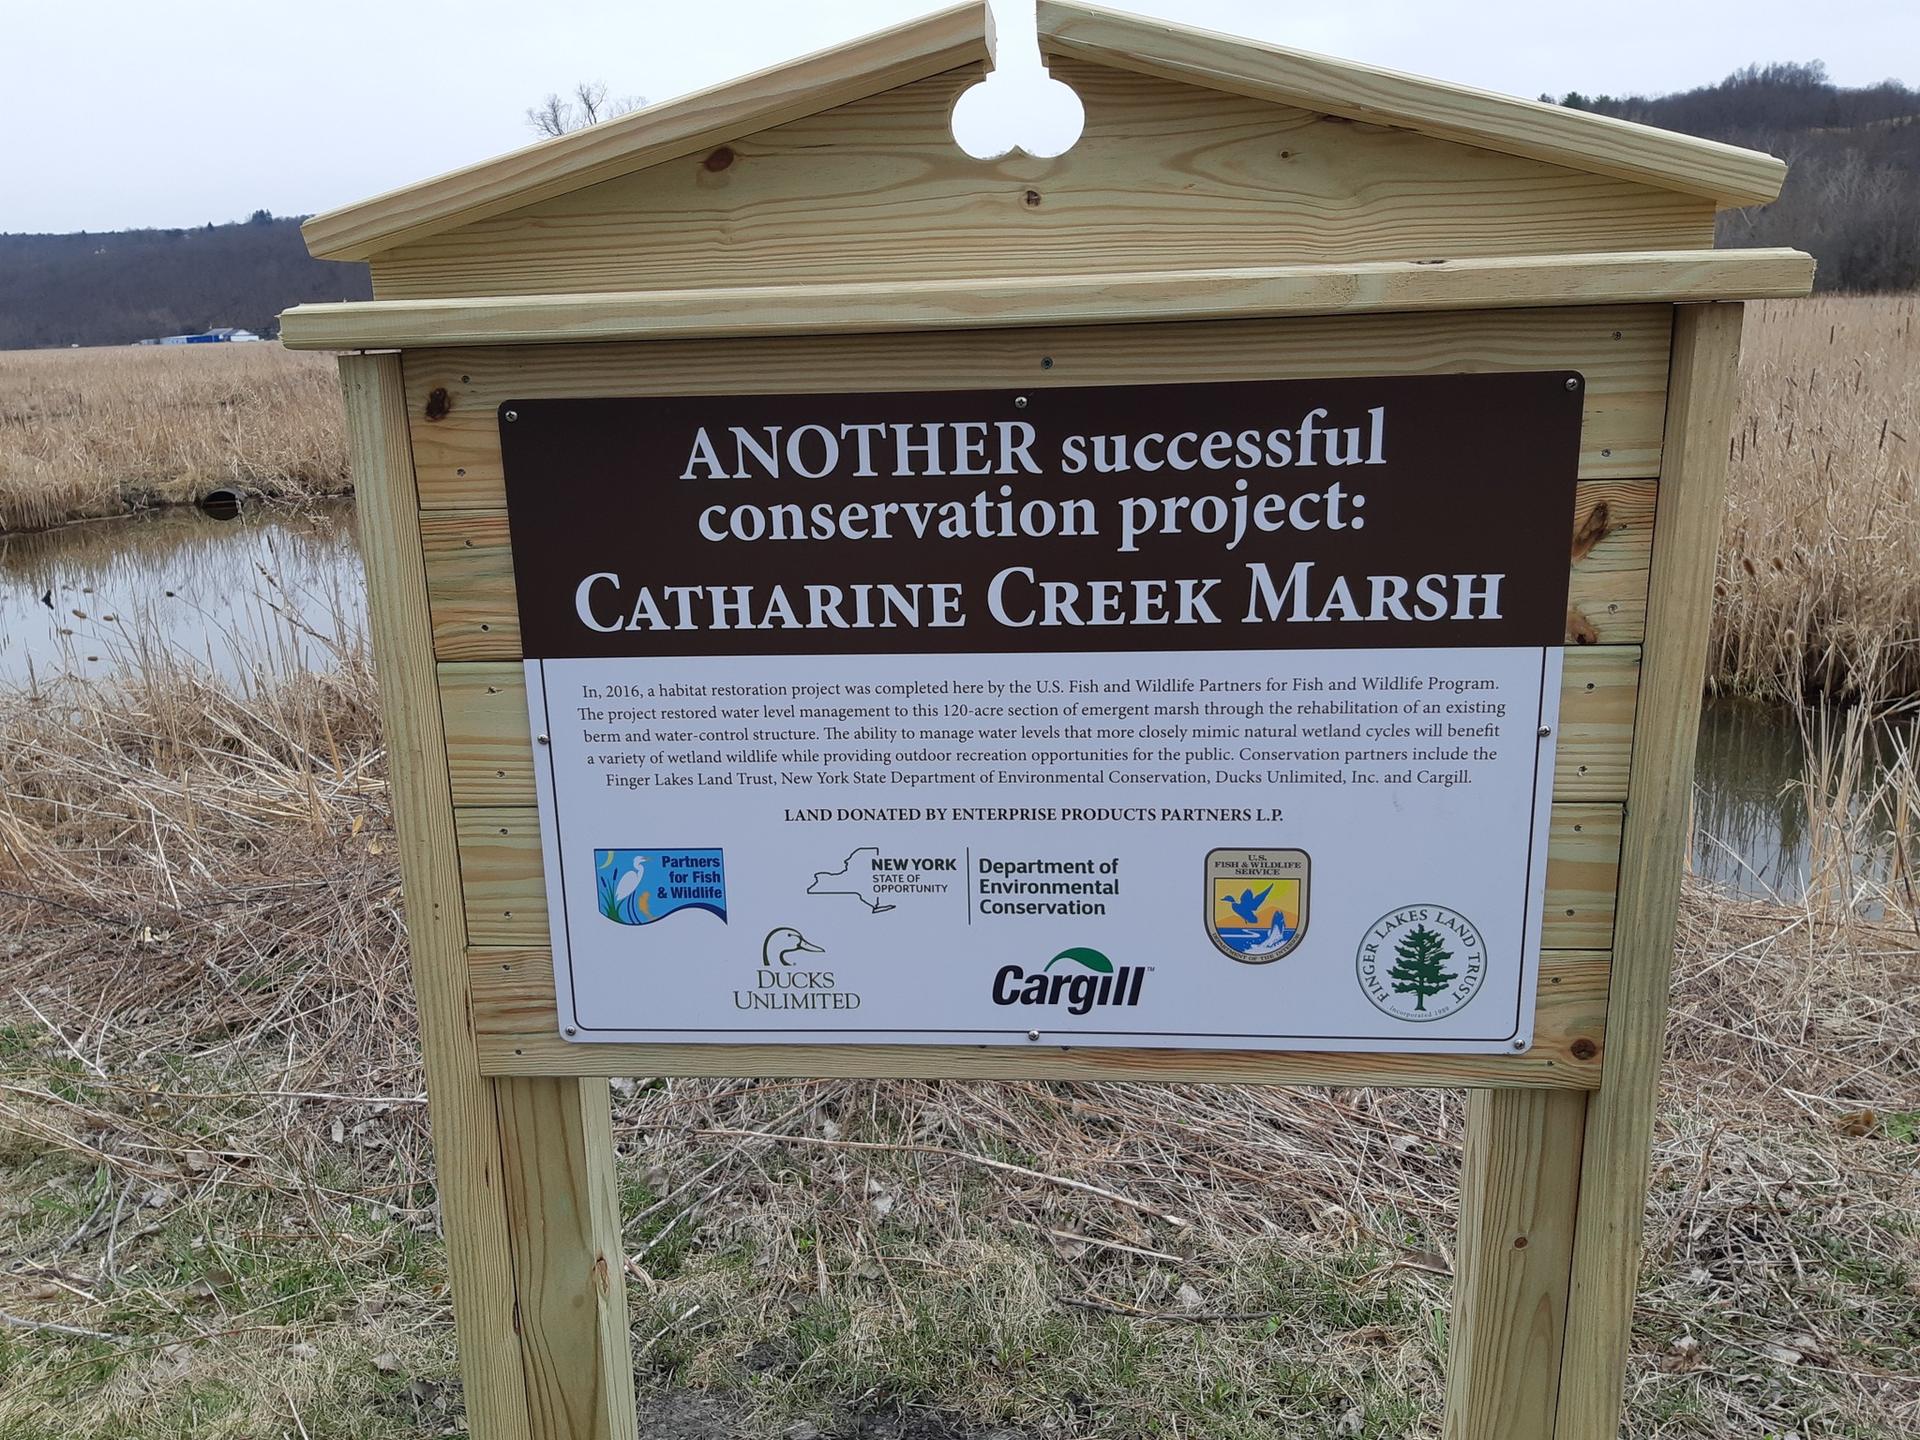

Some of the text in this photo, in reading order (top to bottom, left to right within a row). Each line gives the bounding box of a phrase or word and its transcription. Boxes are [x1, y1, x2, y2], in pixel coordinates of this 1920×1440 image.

[679, 406, 1386, 480] ANOTHER successful
[698, 478, 1365, 552] conservation project:
[575, 561, 1505, 632] CATHARINE CREEK MARSH
[582, 675, 1498, 700] In, 2016, a habitat restoration project was completed here by the U.S. Fish and Wildlife Partners for Fish and Wildlife Program.
[576, 699, 1506, 724] The project restored water level management to this 120-acre section of emergent marsh through the rehabilitation of an existing
[583, 722, 1500, 744] berm and water-control structure. The ability to manage water levels that more closely mimic natural wetland cycles will benefit
[587, 745, 1497, 768] a variety of wetland wildlife while providing outdoor recreation opportunities for the public. Conservation partners include the
[606, 769, 1471, 791] Finger Lakes Land Trust, New York State Department of Environmental Conservation, Ducks Unlimited, Inc. and Cargill.
[784, 807, 1283, 822] LAND DONATED BY ENTERPRISE PRODUCTS PARTNERS L.P.
[662, 855, 720, 868] Partners
[871, 858, 957, 871] NEW YORK
[979, 858, 1119, 878] Department of
[1250, 861, 1302, 869] WILDLIFE
[669, 870, 720, 883] for Fish
[872, 874, 920, 883] STATE OF
[1235, 868, 1280, 876] SERVICE
[657, 886, 722, 899] & Wildlife
[872, 884, 948, 893] OPPORTUNITY
[980, 878, 1119, 895] Environmental
[979, 899, 1106, 915] Conservation
[1362, 909, 1480, 1003] FINGER LAKES LAND TRUST
[757, 969, 835, 988] DUCKS
[992, 964, 1145, 1015] Cargill
[733, 991, 861, 1010] UNLIMITED
